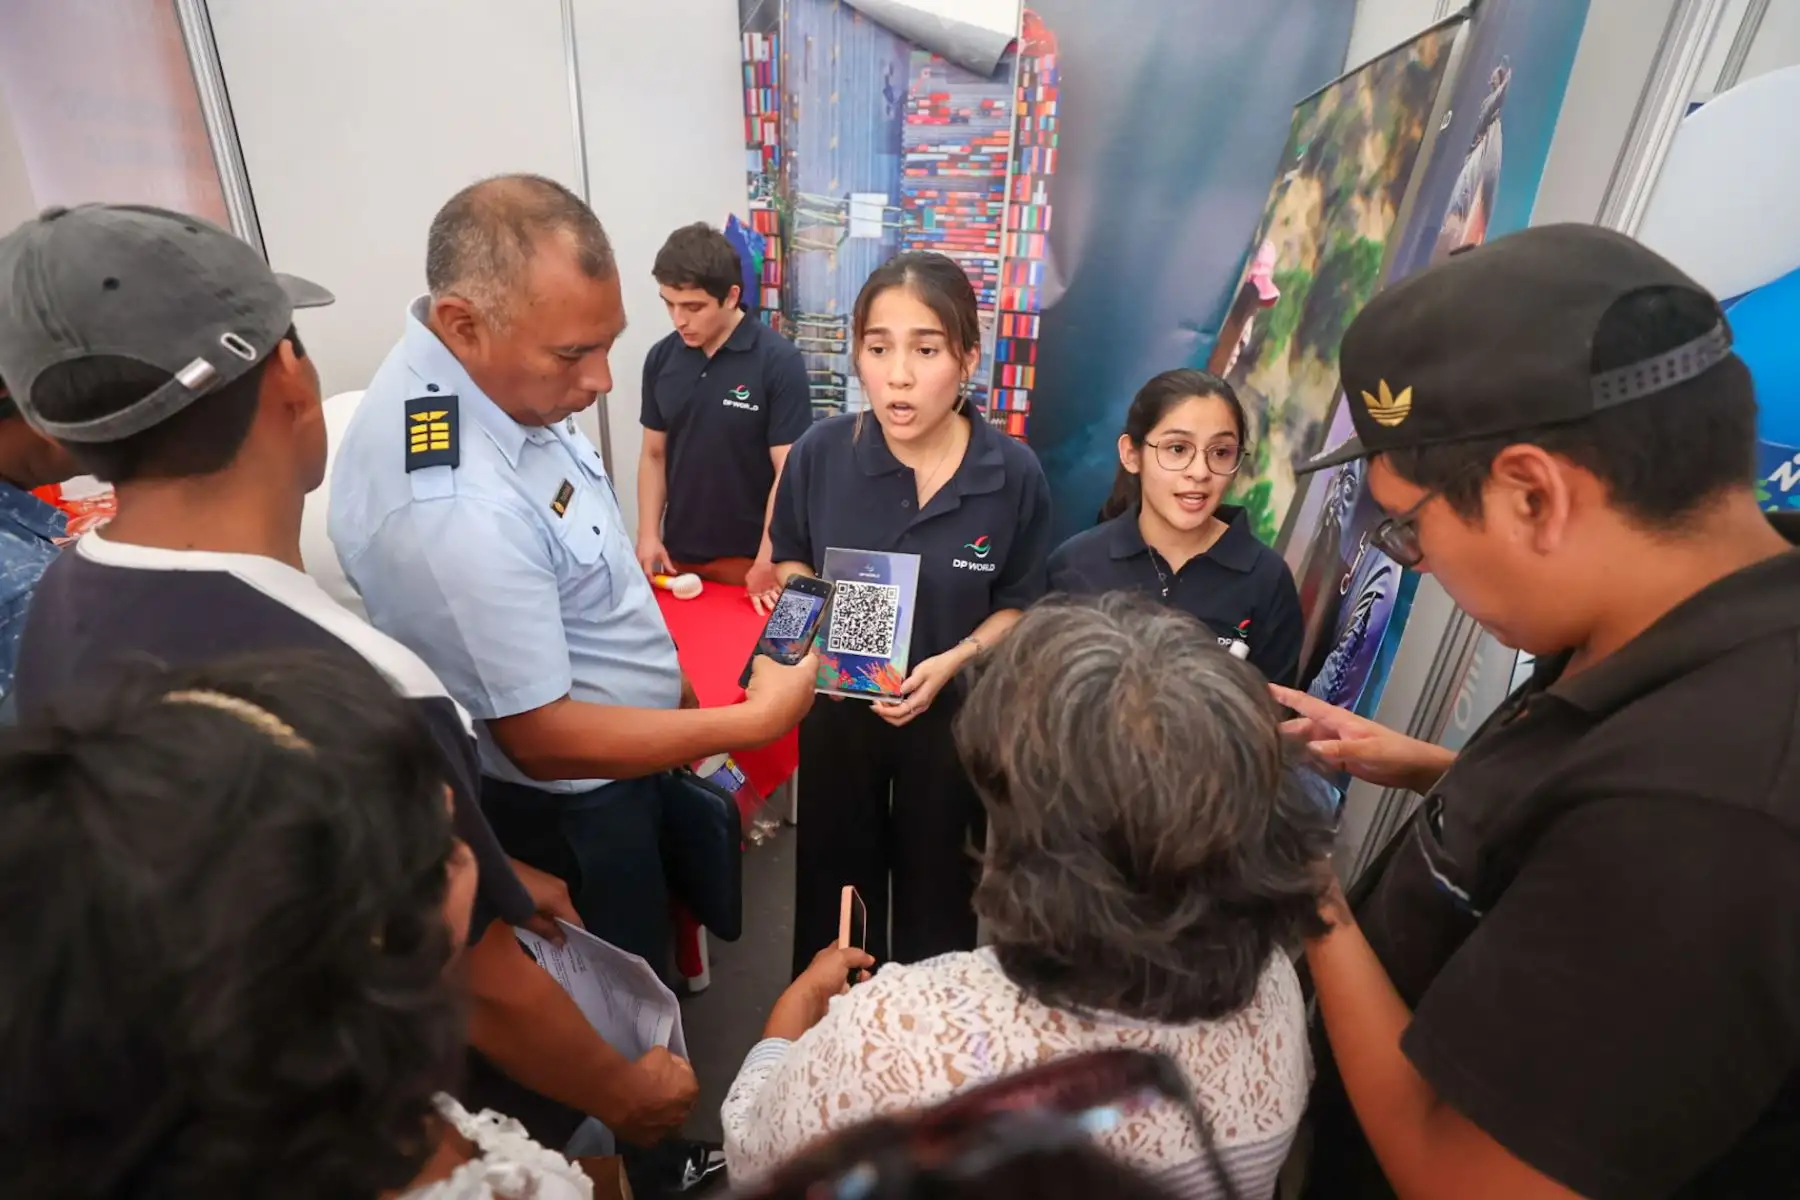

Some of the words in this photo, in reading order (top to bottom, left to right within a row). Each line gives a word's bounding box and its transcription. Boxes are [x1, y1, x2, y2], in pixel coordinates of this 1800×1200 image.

[952, 558, 968, 568] DP
[968, 562, 996, 572] WORLD
[1217, 637, 1232, 646] DP
